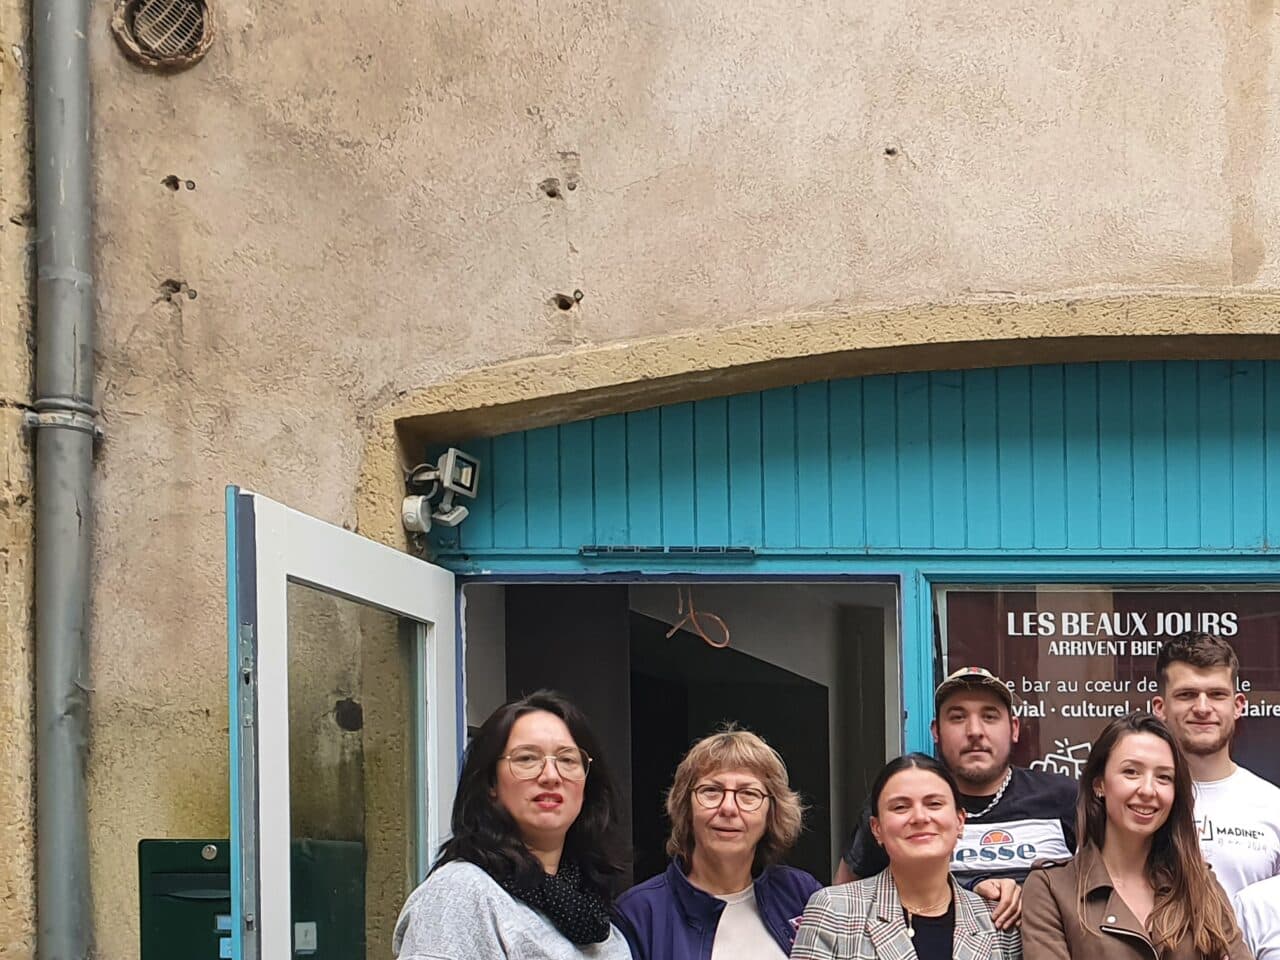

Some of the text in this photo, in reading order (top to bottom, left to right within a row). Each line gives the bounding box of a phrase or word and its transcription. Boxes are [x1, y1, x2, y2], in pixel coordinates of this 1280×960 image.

[1007, 612, 1239, 636] LES BEAUX JOURS
[1048, 640, 1128, 656] ARRIVENT
[1022, 676, 1050, 692] bar
[1057, 680, 1078, 692] au
[1137, 676, 1158, 692] de
[1012, 700, 1046, 717] vial
[1061, 700, 1130, 717] culturel
